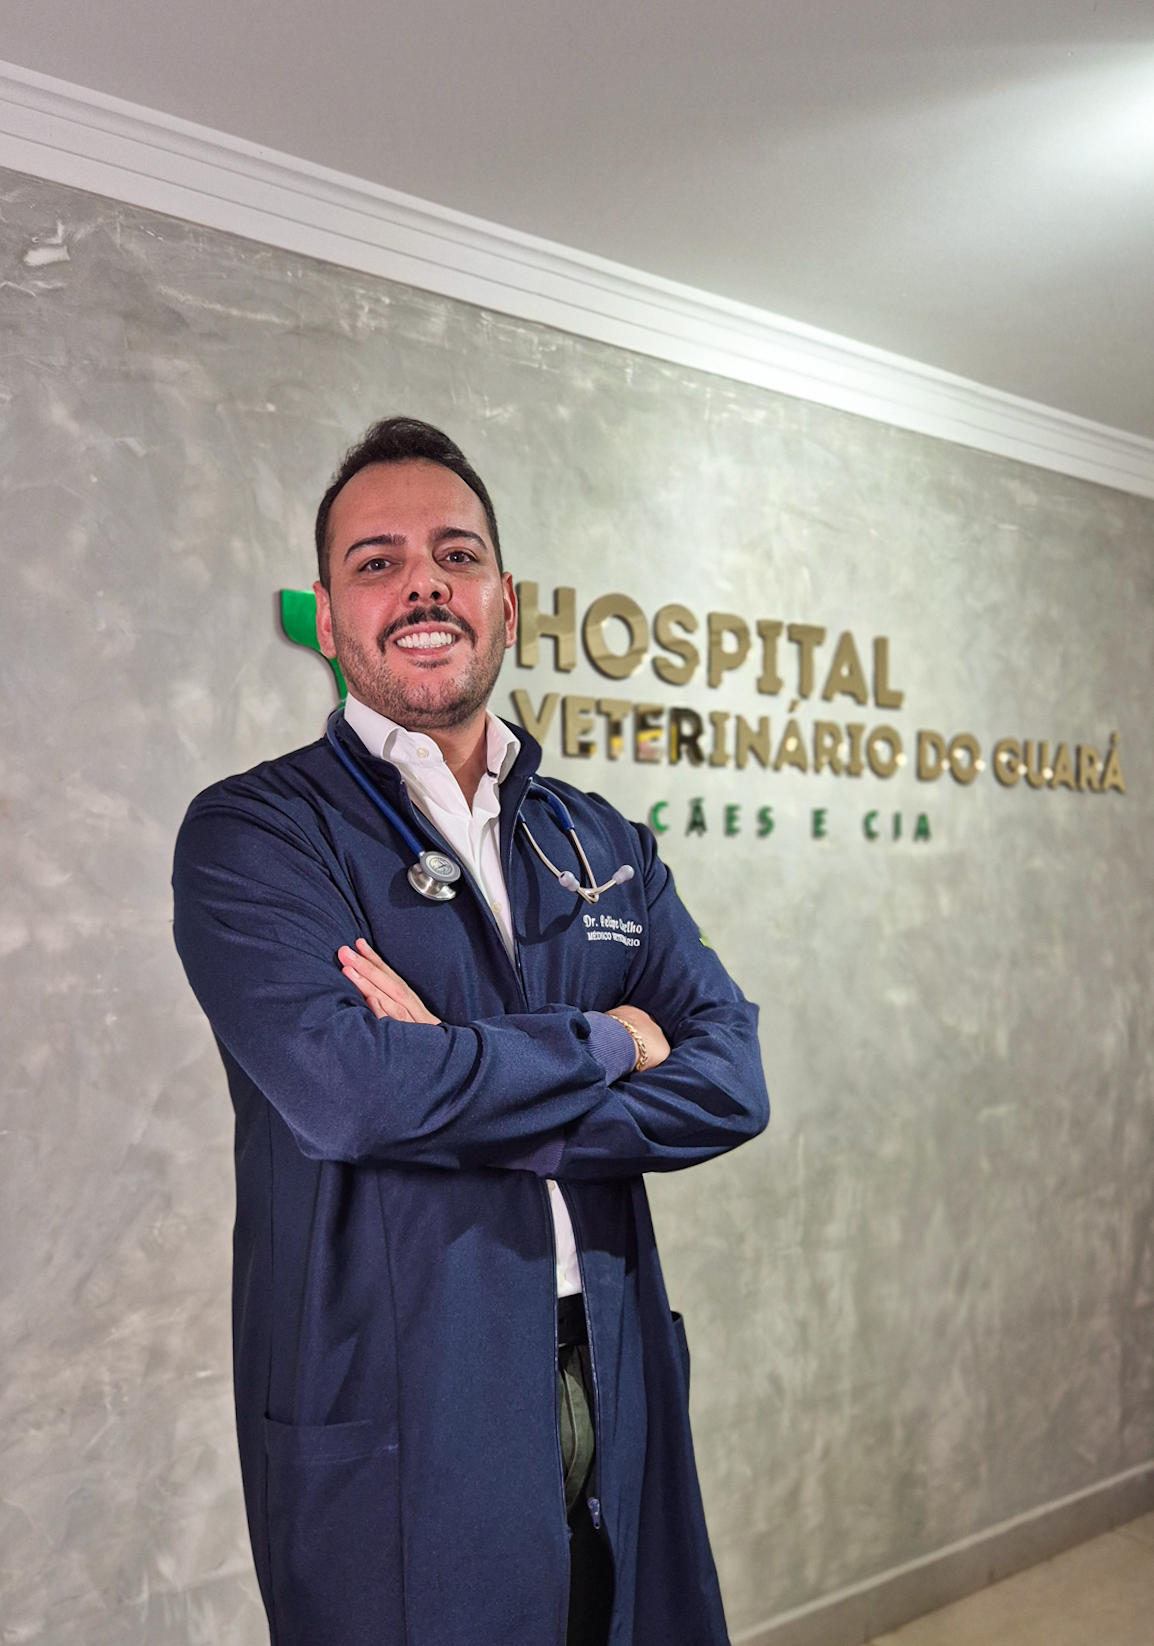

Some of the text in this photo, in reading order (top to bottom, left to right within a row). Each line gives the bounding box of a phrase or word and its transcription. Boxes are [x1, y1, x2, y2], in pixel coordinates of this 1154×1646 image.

[514, 579, 904, 710] HOSPITAL
[510, 689, 1127, 794] VETERINÁRIO DO GUARÁ
[650, 798, 931, 842] CÃES E CIA
[582, 914, 599, 928] Dr.
